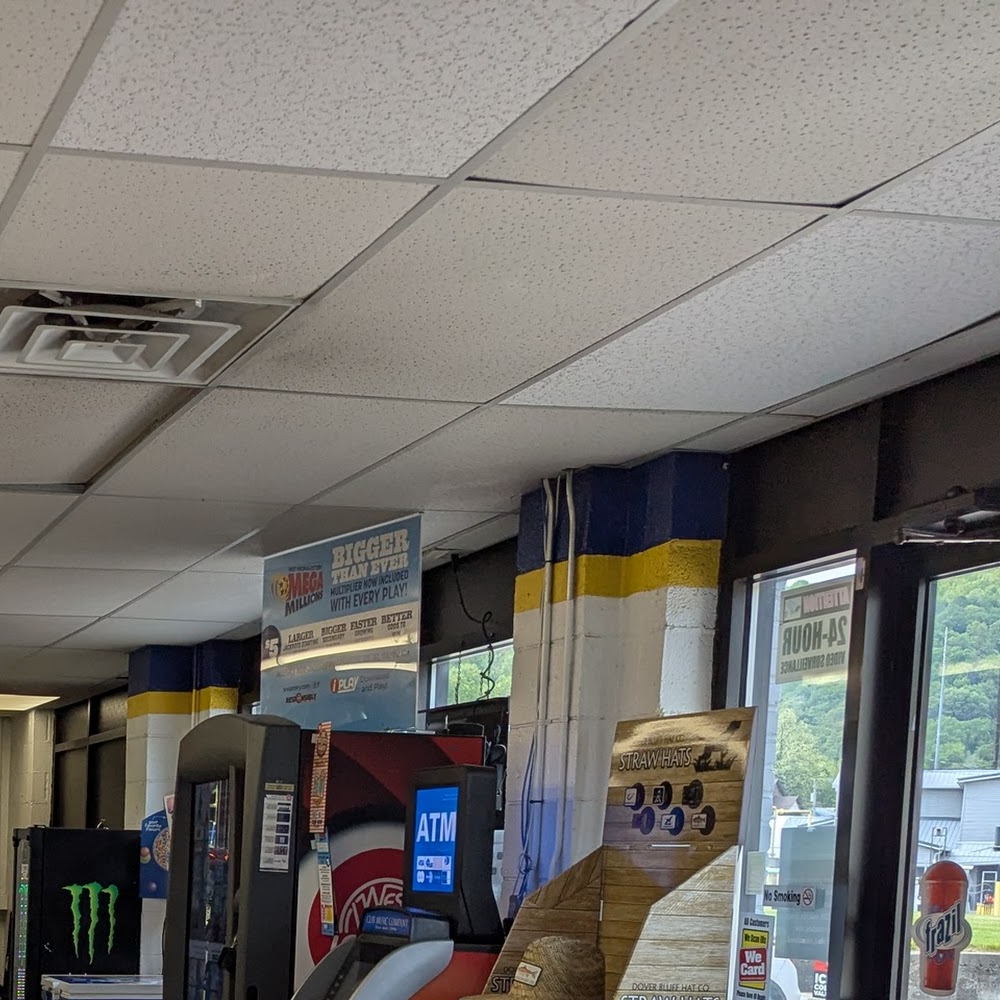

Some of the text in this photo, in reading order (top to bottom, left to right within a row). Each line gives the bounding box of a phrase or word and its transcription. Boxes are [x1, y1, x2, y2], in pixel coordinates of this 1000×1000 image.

[332, 529, 410, 569] BIGGER
[332, 553, 409, 585] THAN EVER
[288, 570, 323, 600] MEGA
[330, 570, 409, 597] MULTIPLIER NOW INCLUDED
[285, 591, 323, 617] MILLIONS
[330, 582, 408, 612] WITH EVERY PLAY!
[350, 617, 377, 631] FASTER
[381, 610, 413, 624] BETTER
[288, 630, 314, 643] LARGER
[321, 624, 347, 637] BIGGER
[619, 747, 692, 771] STRAW HATS
[416, 811, 456, 842] ATM
[764, 889, 800, 905] No Smoking
[925, 902, 961, 953] frazil
[745, 950, 762, 963] We
[741, 963, 765, 975] Card
[632, 983, 657, 991] DOVER
